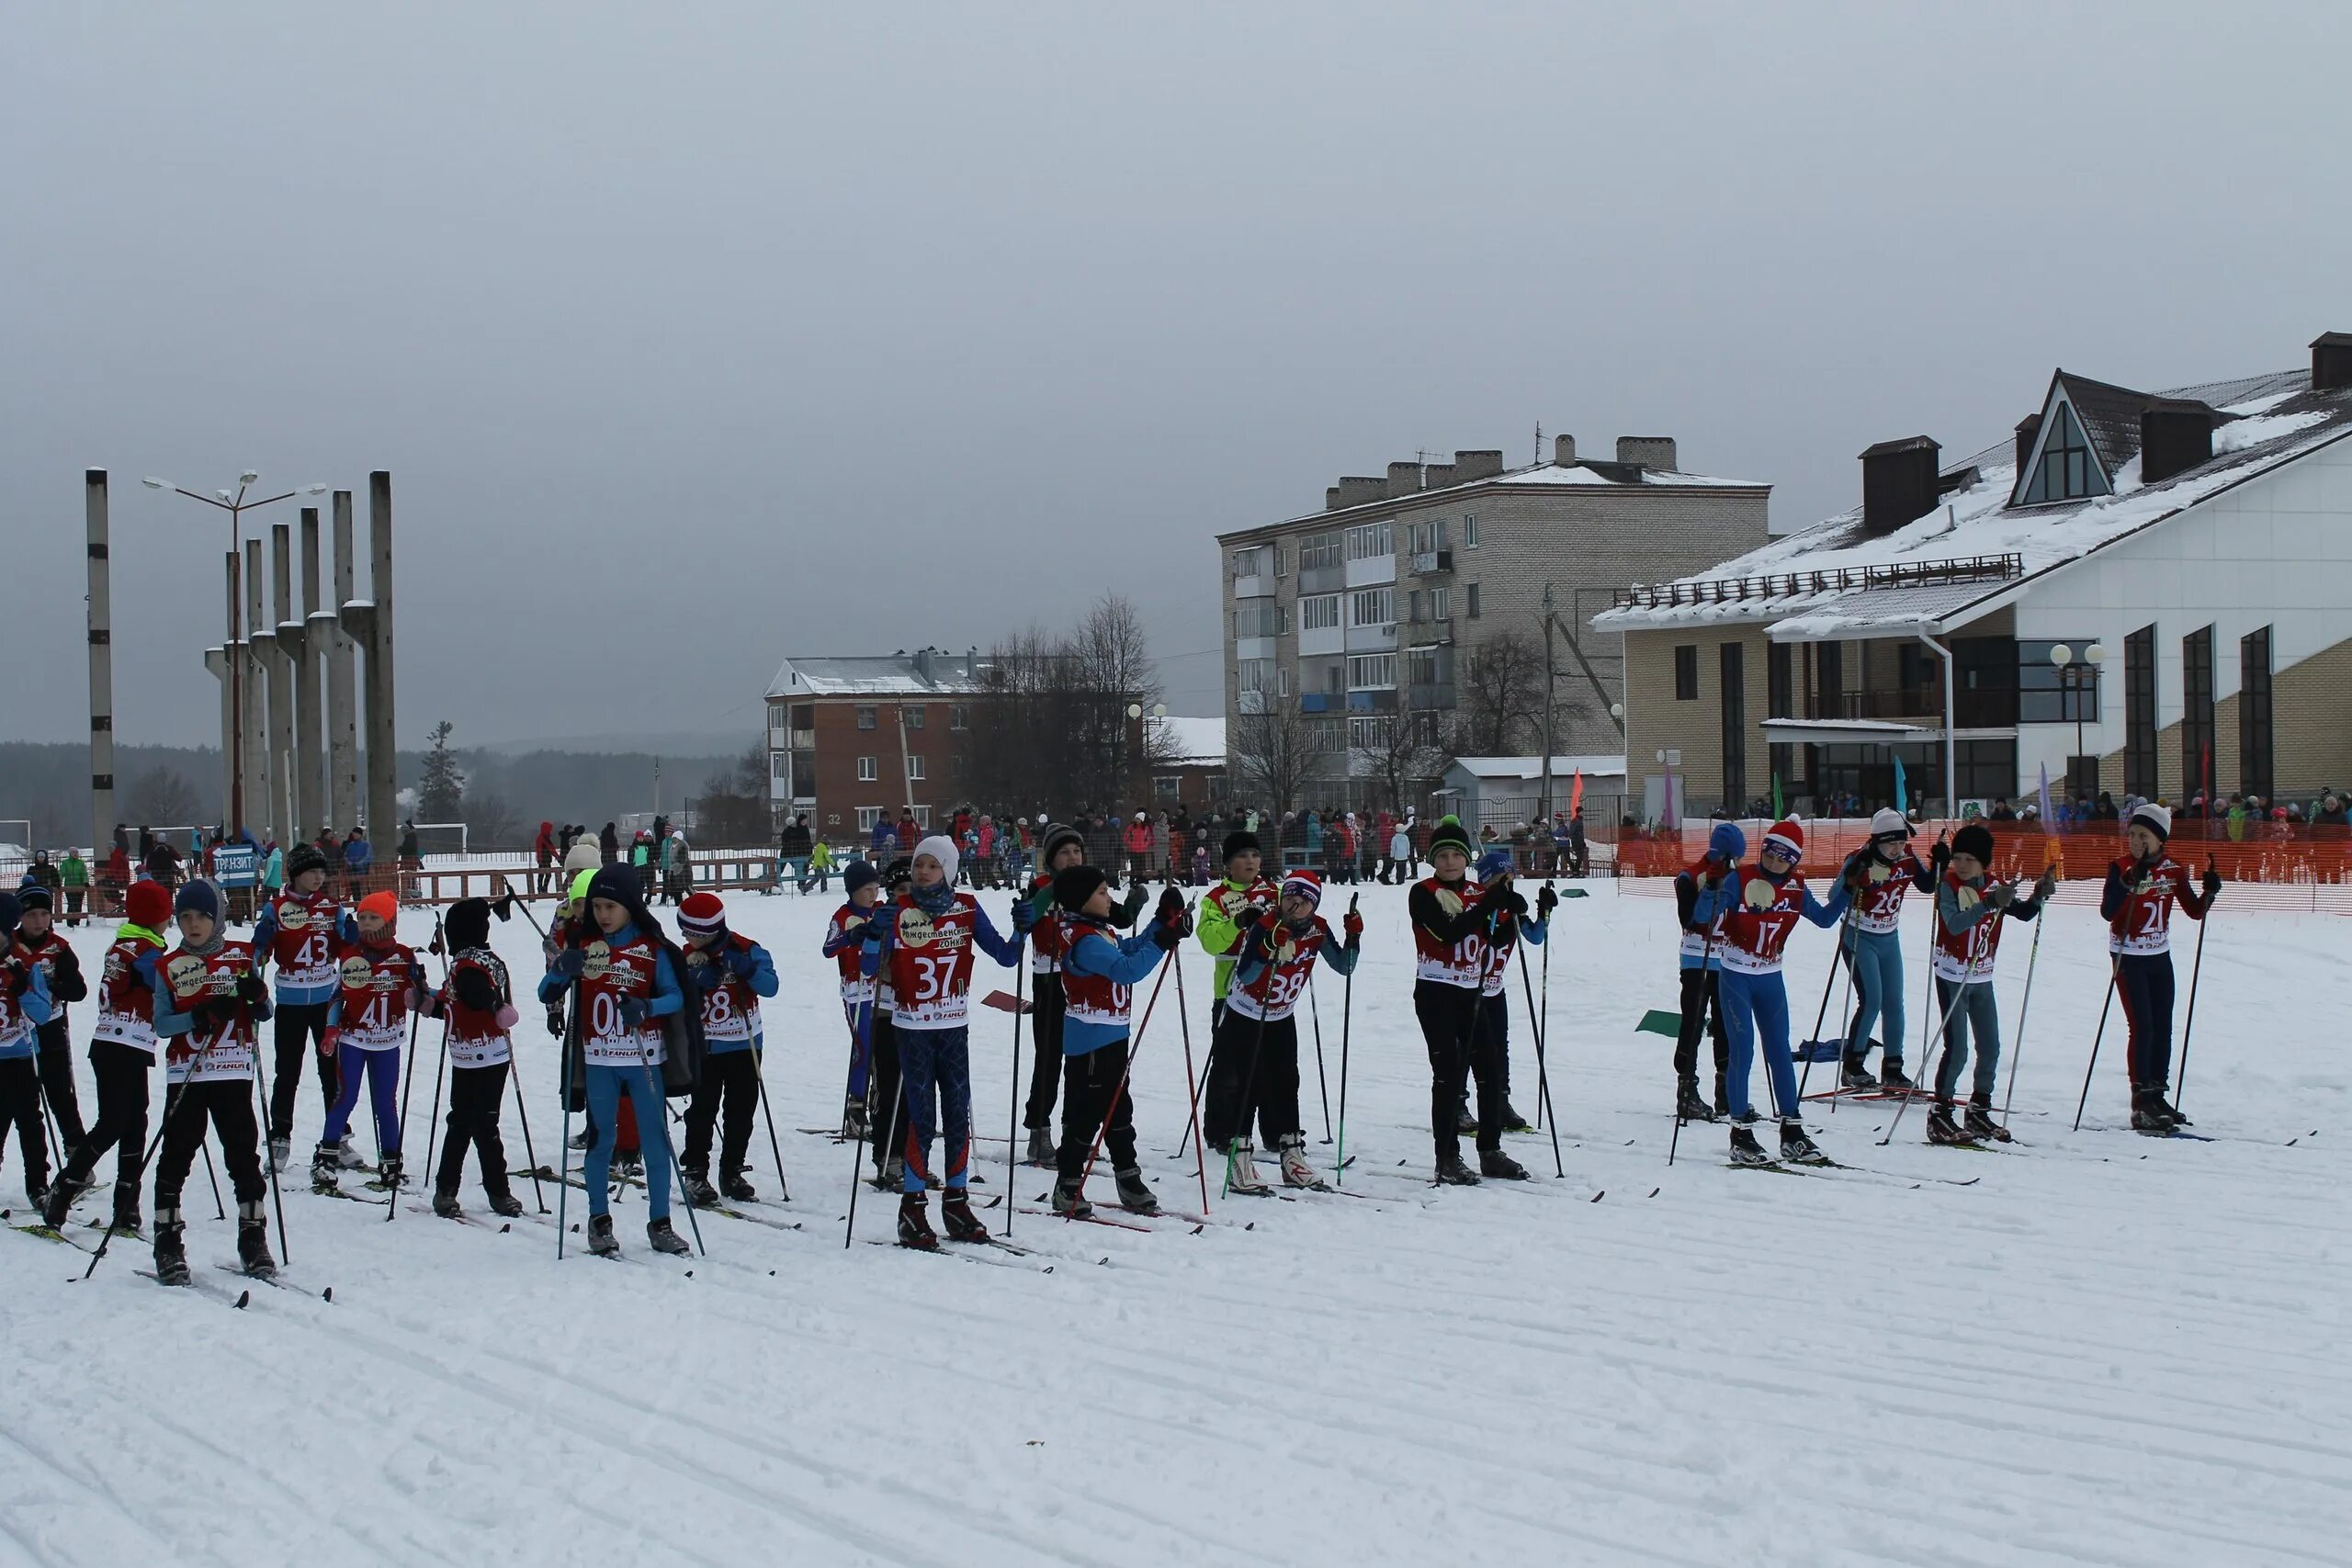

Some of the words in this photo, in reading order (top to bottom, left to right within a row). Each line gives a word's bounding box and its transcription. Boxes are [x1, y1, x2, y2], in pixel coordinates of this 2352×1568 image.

[828, 814, 841, 825] 32
[213, 856, 253, 870] ТРАНЗИТ
[1870, 887, 1901, 914] 26
[2140, 900, 2164, 933] 21
[294, 935, 328, 966] 43
[1755, 920, 1781, 955] 17
[914, 955, 958, 999] 37
[1262, 972, 1305, 1004] 38
[359, 997, 389, 1028] 41
